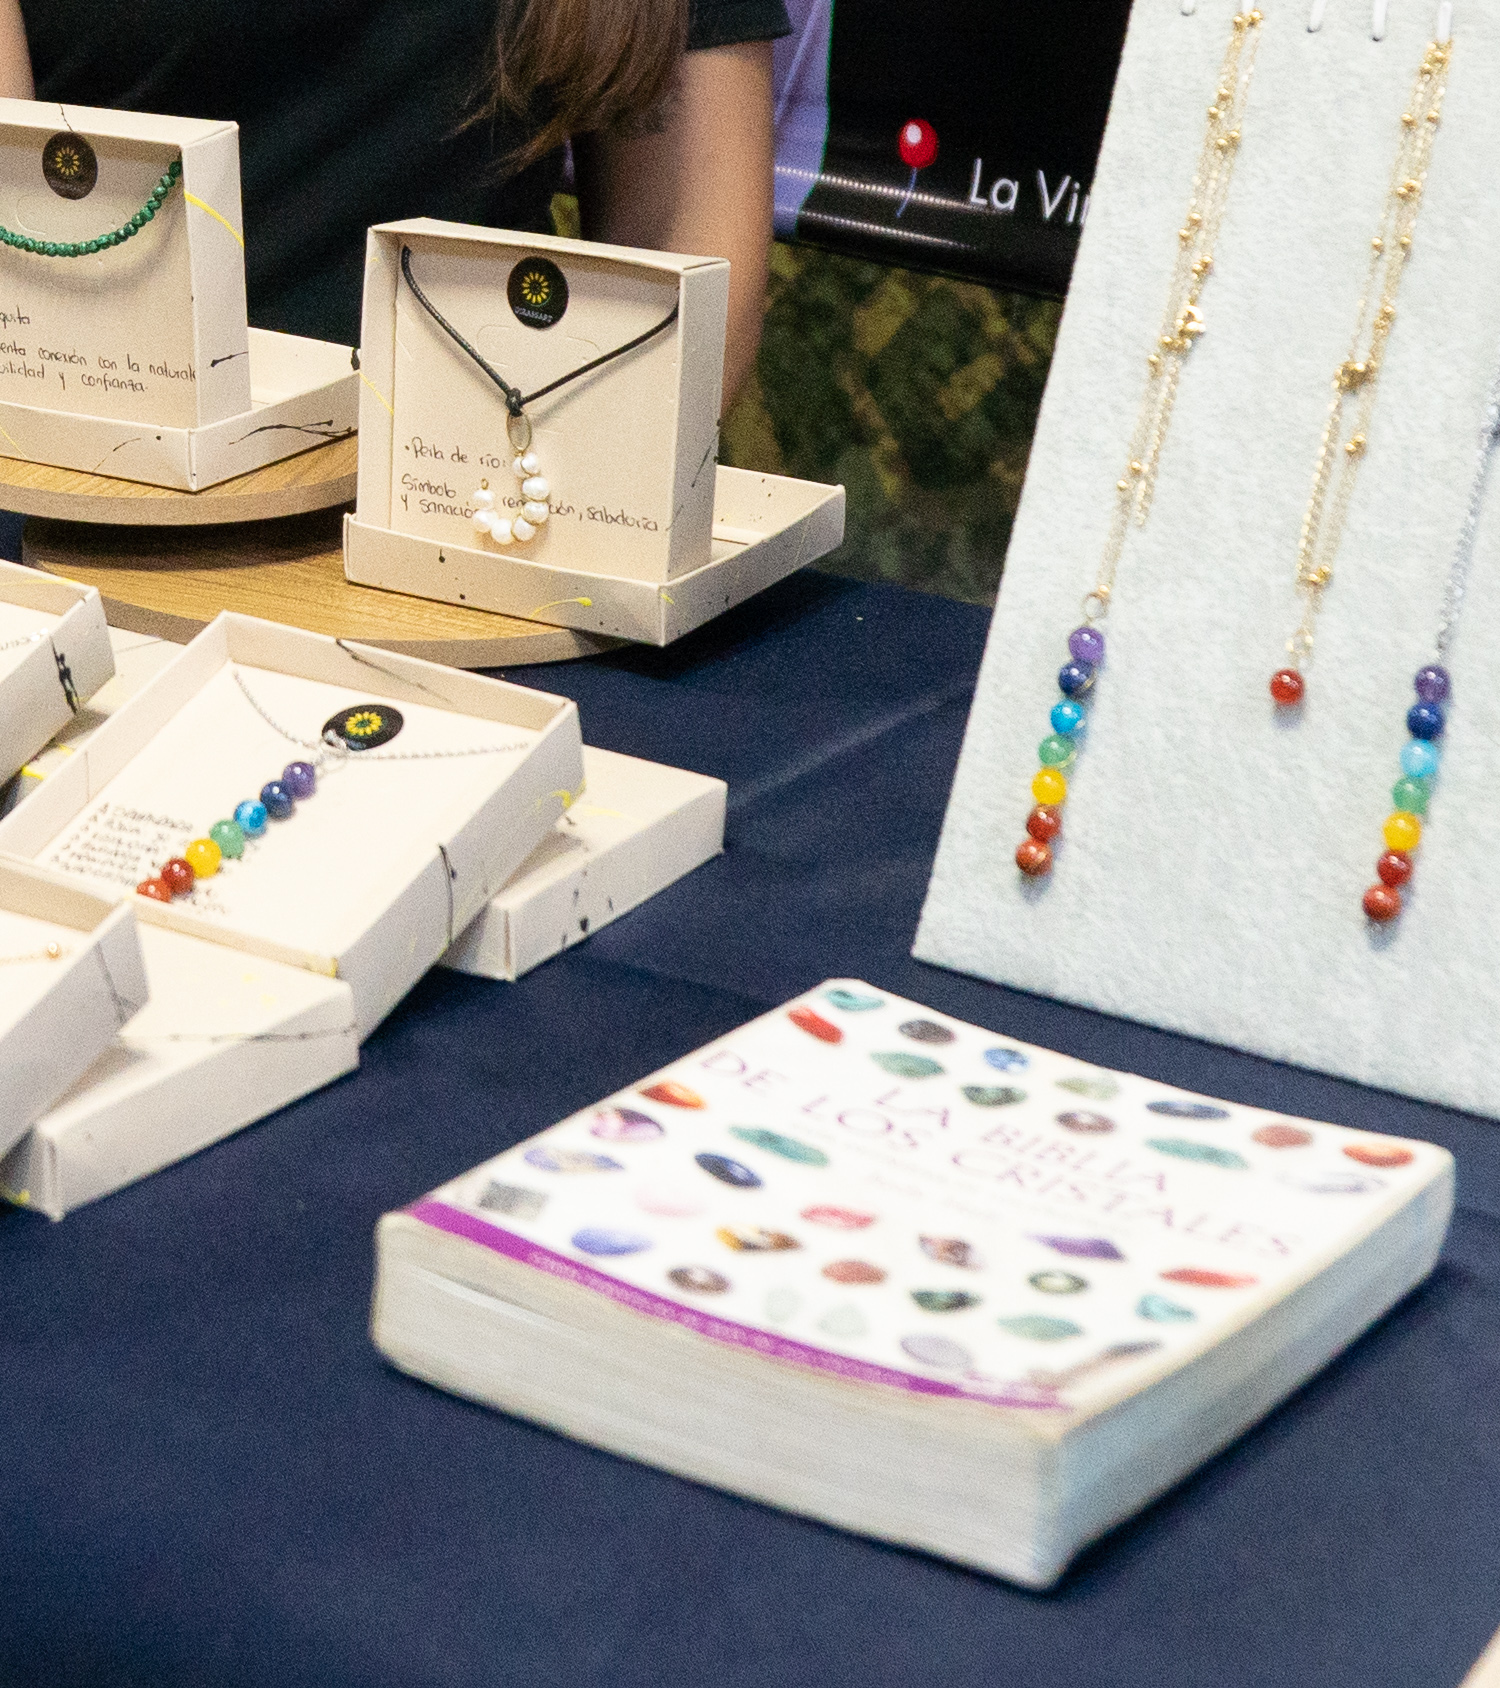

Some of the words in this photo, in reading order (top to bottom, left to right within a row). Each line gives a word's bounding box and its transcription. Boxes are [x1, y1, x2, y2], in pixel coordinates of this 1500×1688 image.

[969, 157, 1020, 212] La
[97, 355, 118, 371] con
[125, 352, 141, 374] la
[449, 444, 469, 464] de
[417, 497, 480, 521] sanació
[873, 1086, 951, 1128] LA
[980, 1124, 1167, 1193] BIBLIA
[800, 1095, 920, 1150] LOS
[949, 1150, 1293, 1259] CRISTALES
